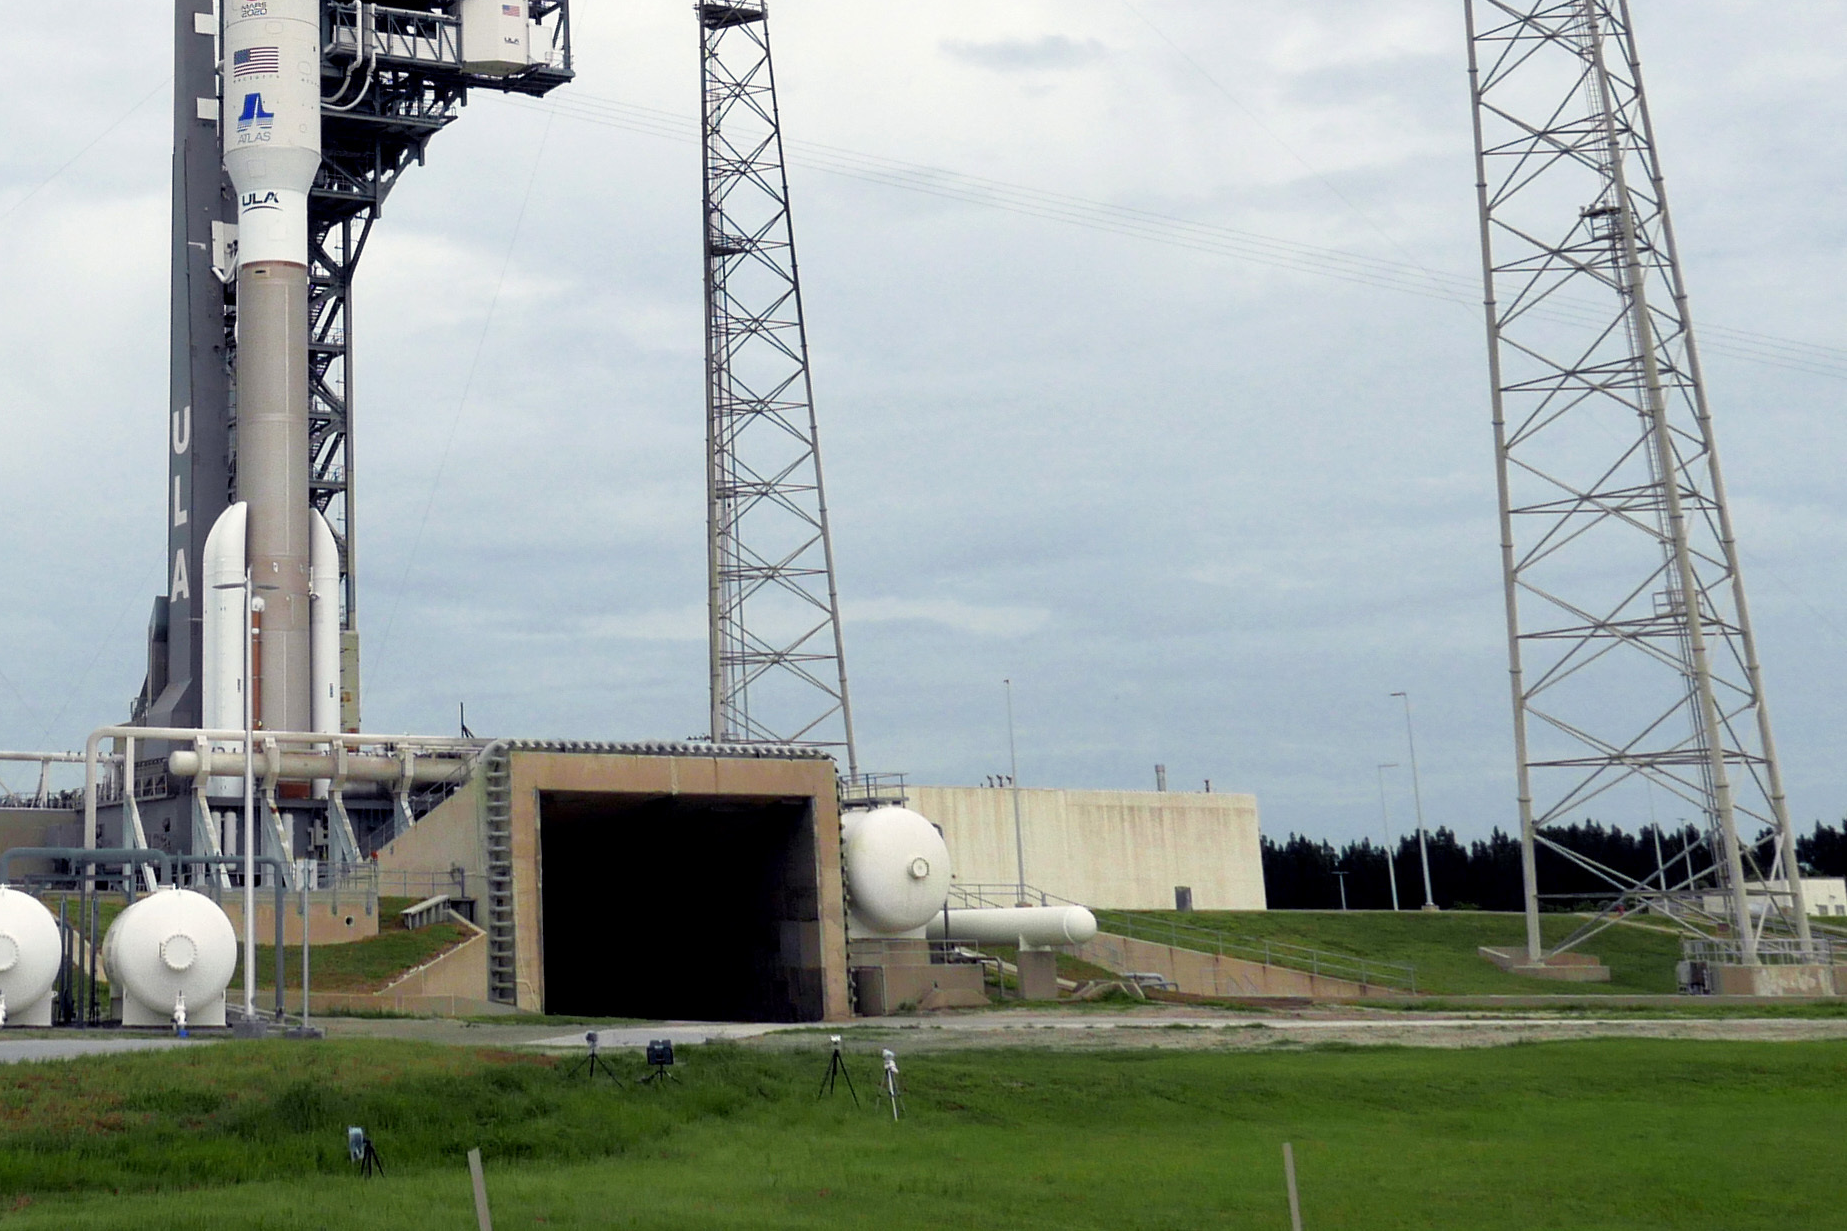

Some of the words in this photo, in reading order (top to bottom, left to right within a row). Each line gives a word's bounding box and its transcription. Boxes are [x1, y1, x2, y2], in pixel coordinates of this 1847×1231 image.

[242, 9, 267, 18] 2020
[238, 131, 271, 145] ATLAS
[242, 191, 279, 206] ULA
